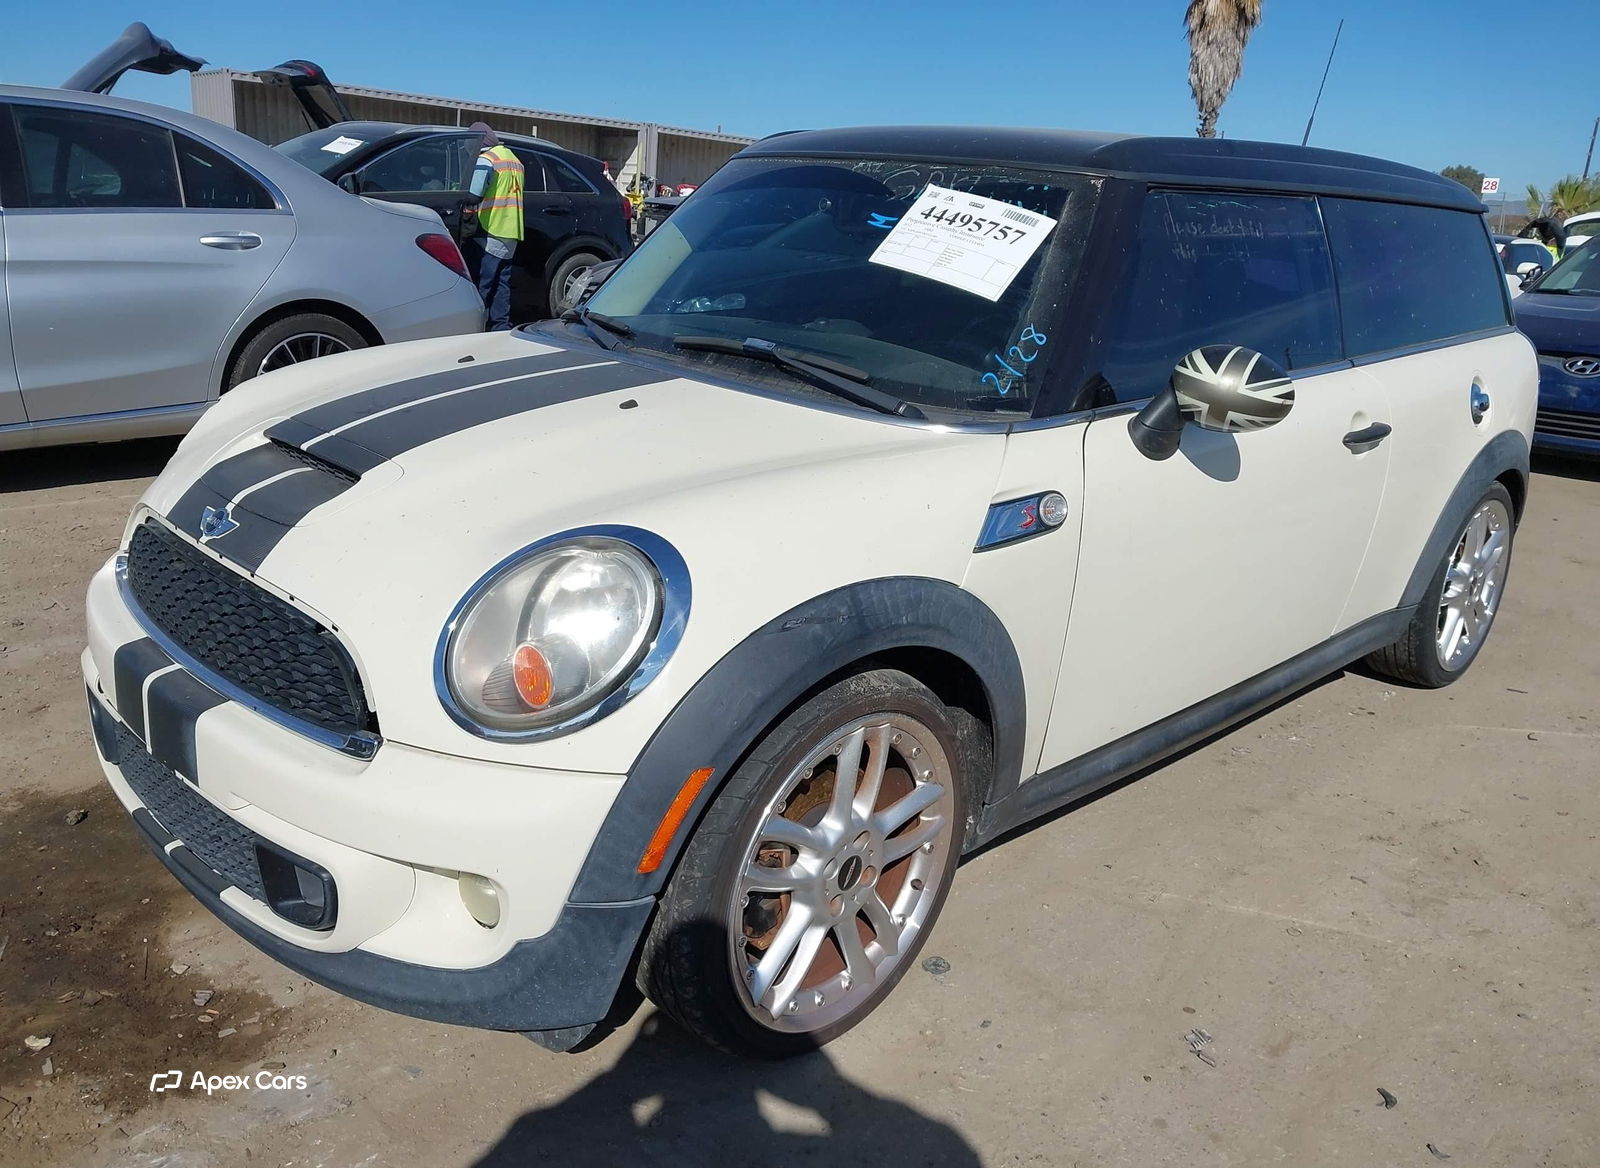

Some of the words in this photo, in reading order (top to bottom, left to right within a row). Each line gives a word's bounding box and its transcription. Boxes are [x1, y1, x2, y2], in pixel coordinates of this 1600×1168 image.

[1483, 180, 1498, 191] 28
[906, 216, 936, 228] Progressive
[936, 223, 959, 234] Casualty
[959, 229, 986, 242] Insurance
[920, 205, 1027, 245] 44495757
[981, 323, 1047, 395] 2/28
[1019, 503, 1036, 530] S
